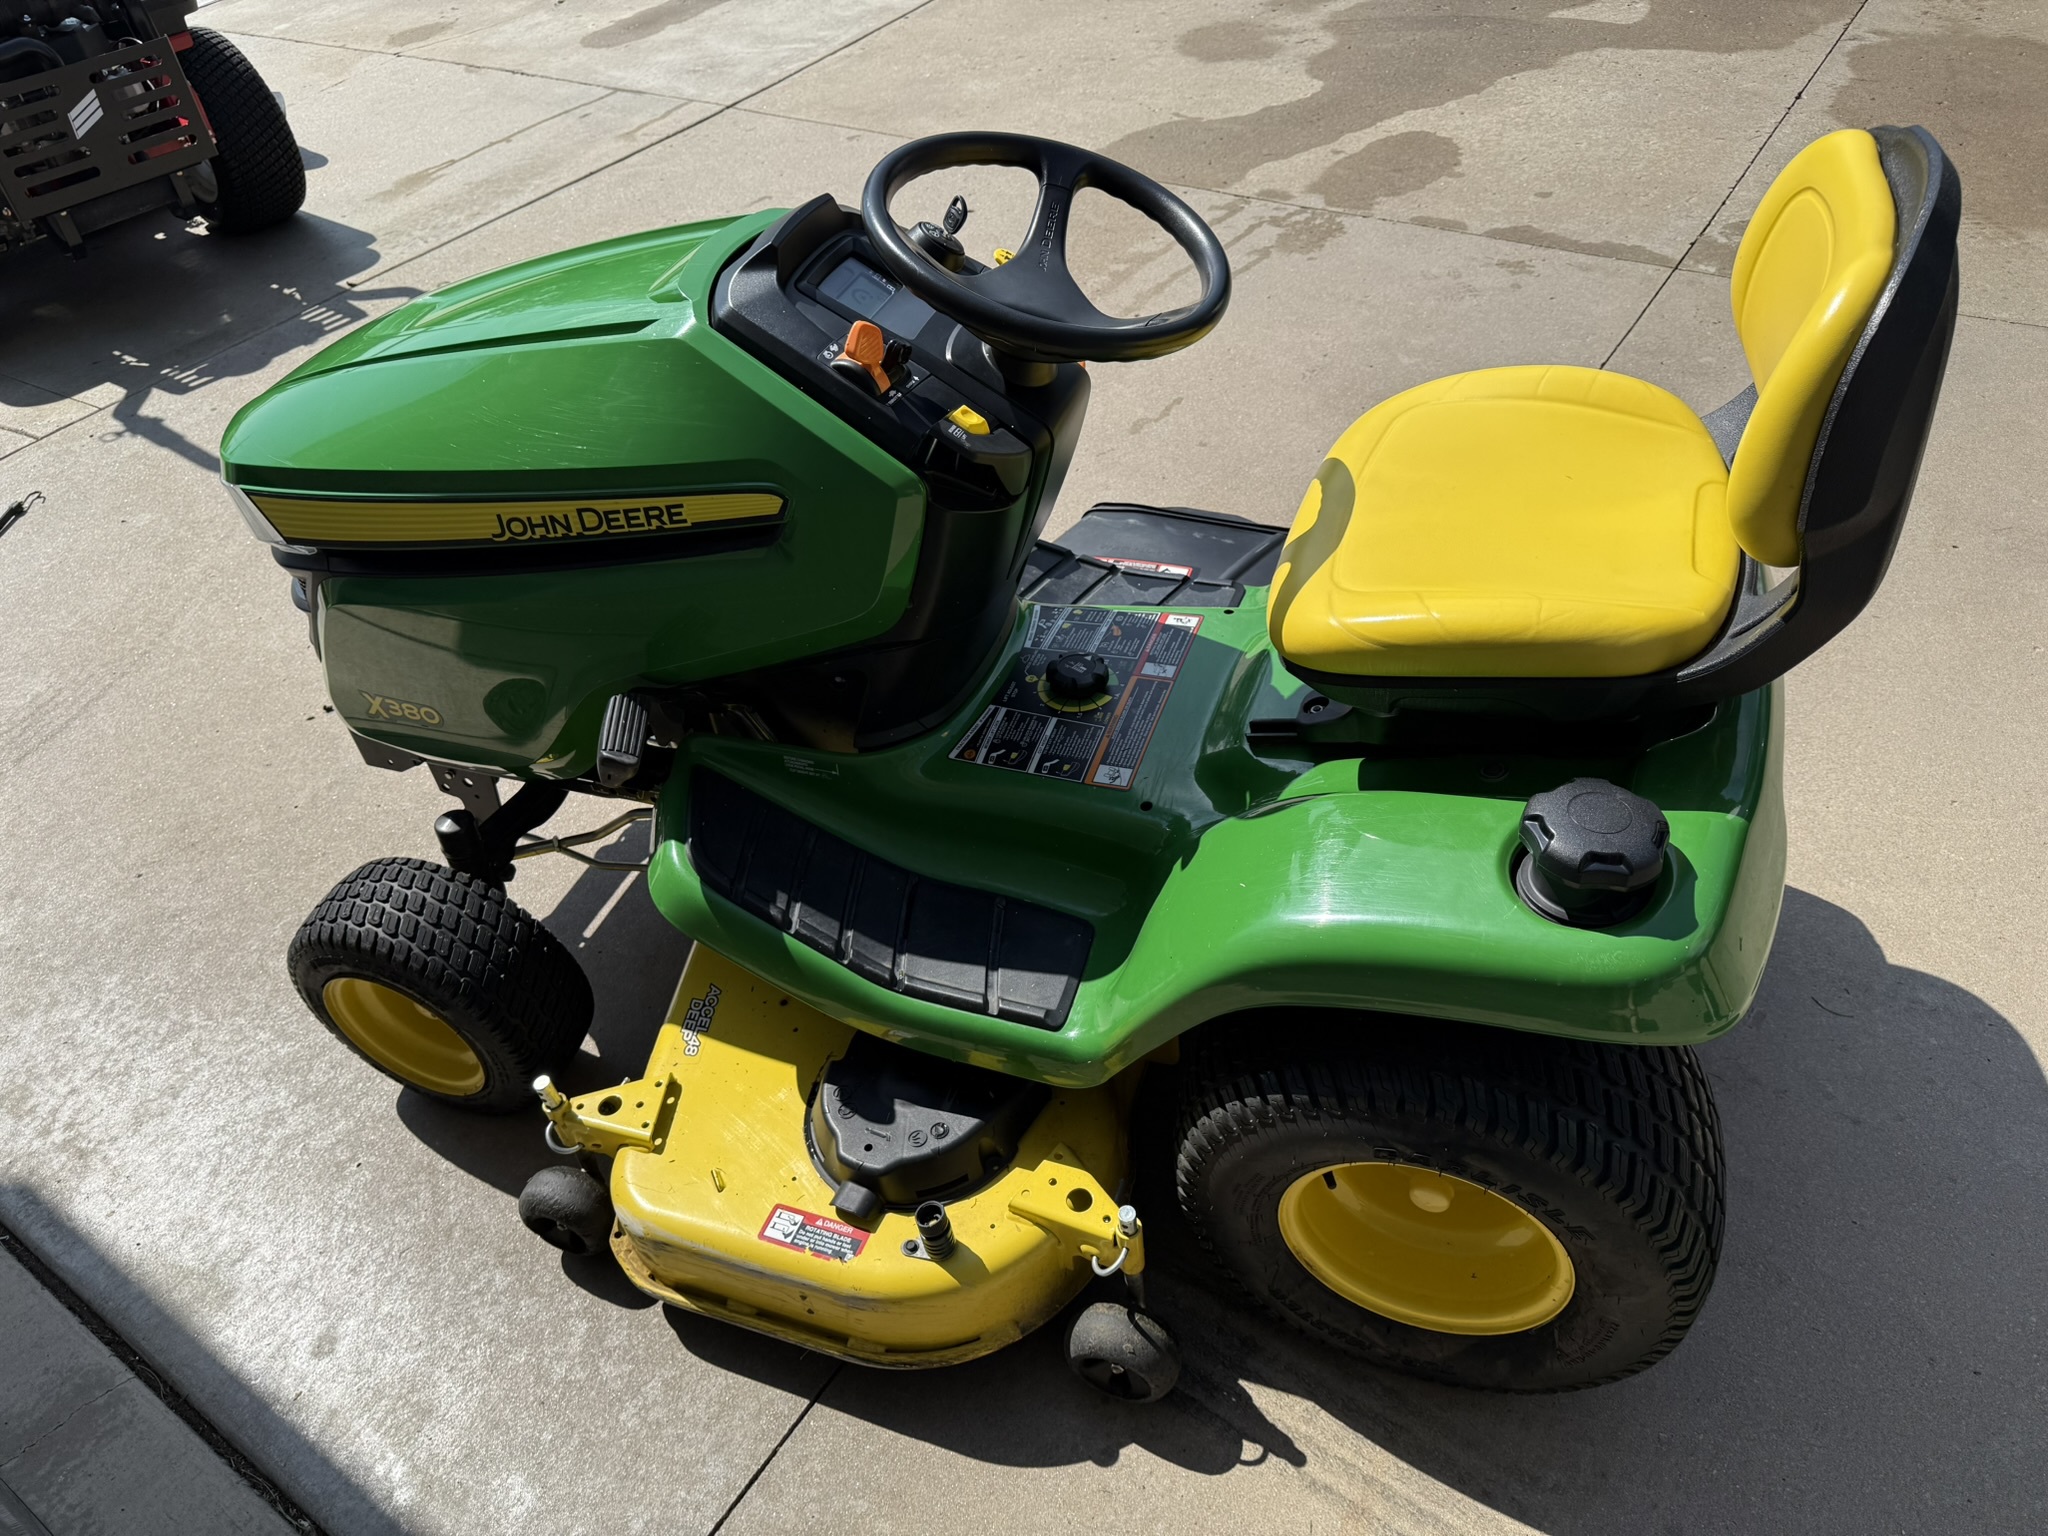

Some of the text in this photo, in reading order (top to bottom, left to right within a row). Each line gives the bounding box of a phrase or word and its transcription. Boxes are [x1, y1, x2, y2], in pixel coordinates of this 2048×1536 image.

[1042, 201, 1060, 249] DEERE
[491, 503, 689, 540] JOHN DEERE
[359, 691, 441, 725] X380
[682, 998, 704, 1041] DEEP
[695, 984, 721, 1034] ACCEL
[684, 1035, 701, 1056] 48
[804, 1225, 851, 1242] ROTATING BLADE
[824, 1220, 854, 1234] DANGER
